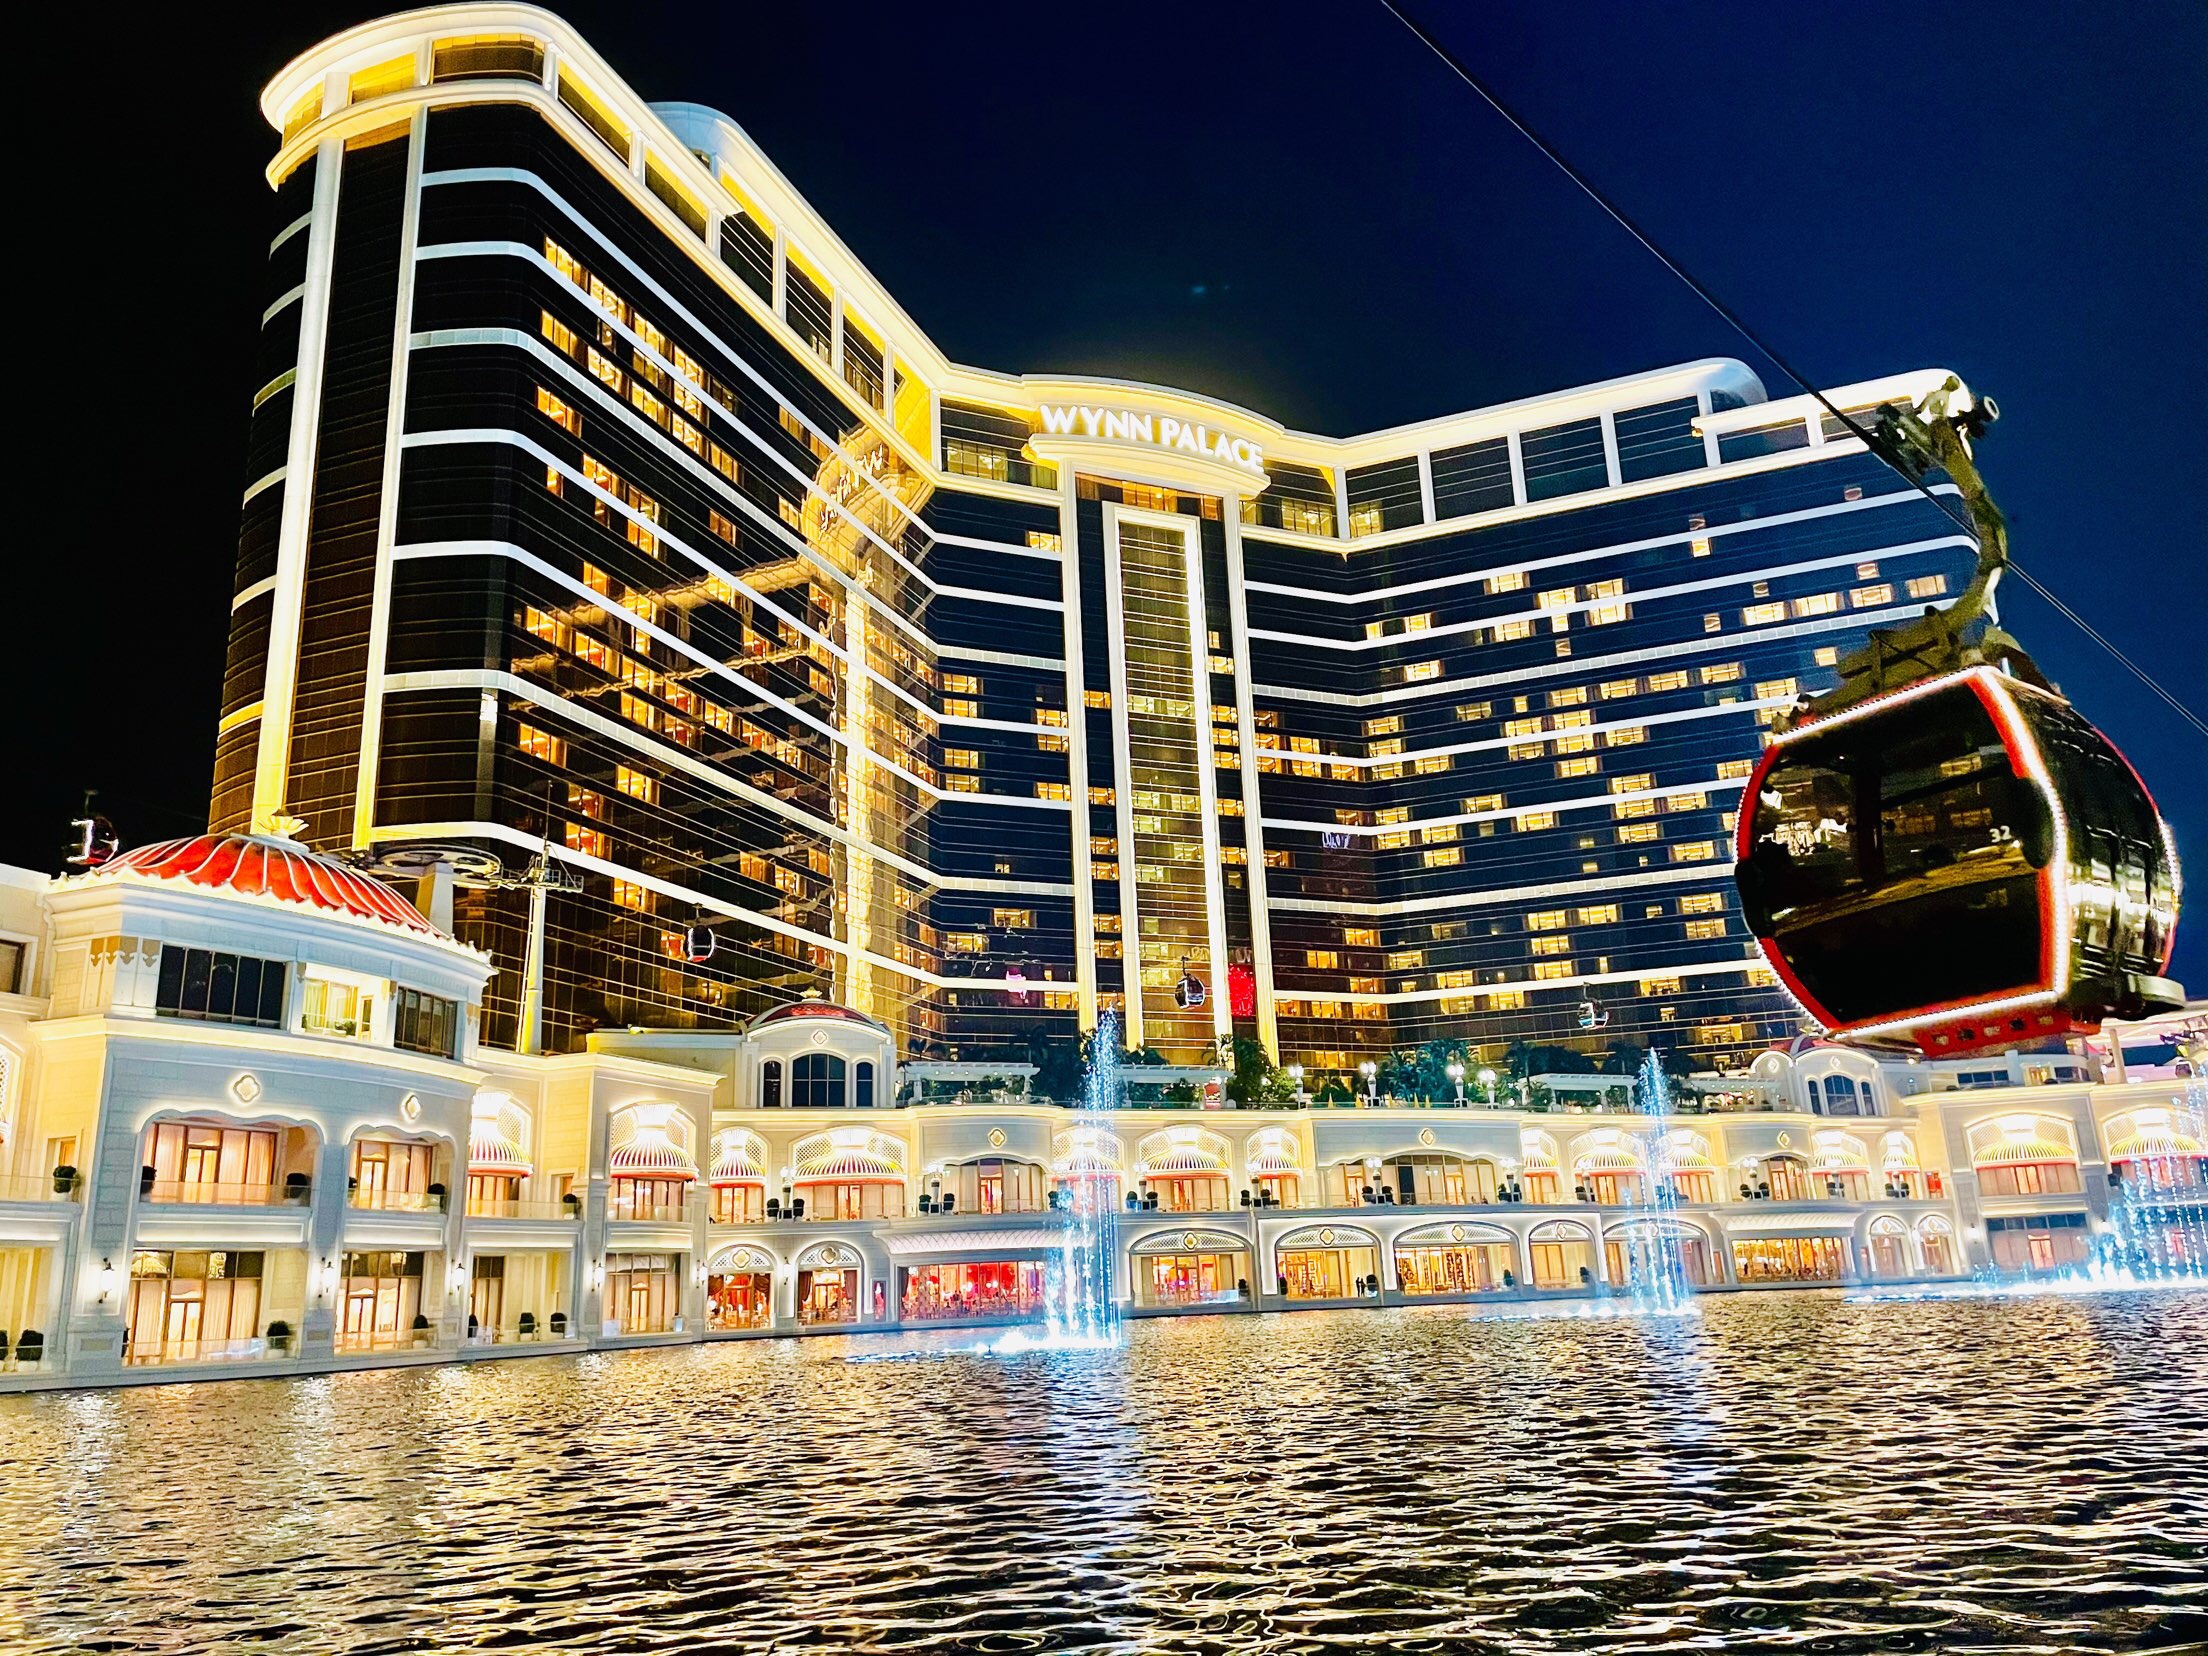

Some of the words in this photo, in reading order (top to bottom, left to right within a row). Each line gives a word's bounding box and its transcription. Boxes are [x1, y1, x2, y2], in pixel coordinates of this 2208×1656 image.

[1040, 405, 1152, 443] WYNN
[1161, 417, 1264, 474] PALACE
[1989, 825, 2012, 843] 32
